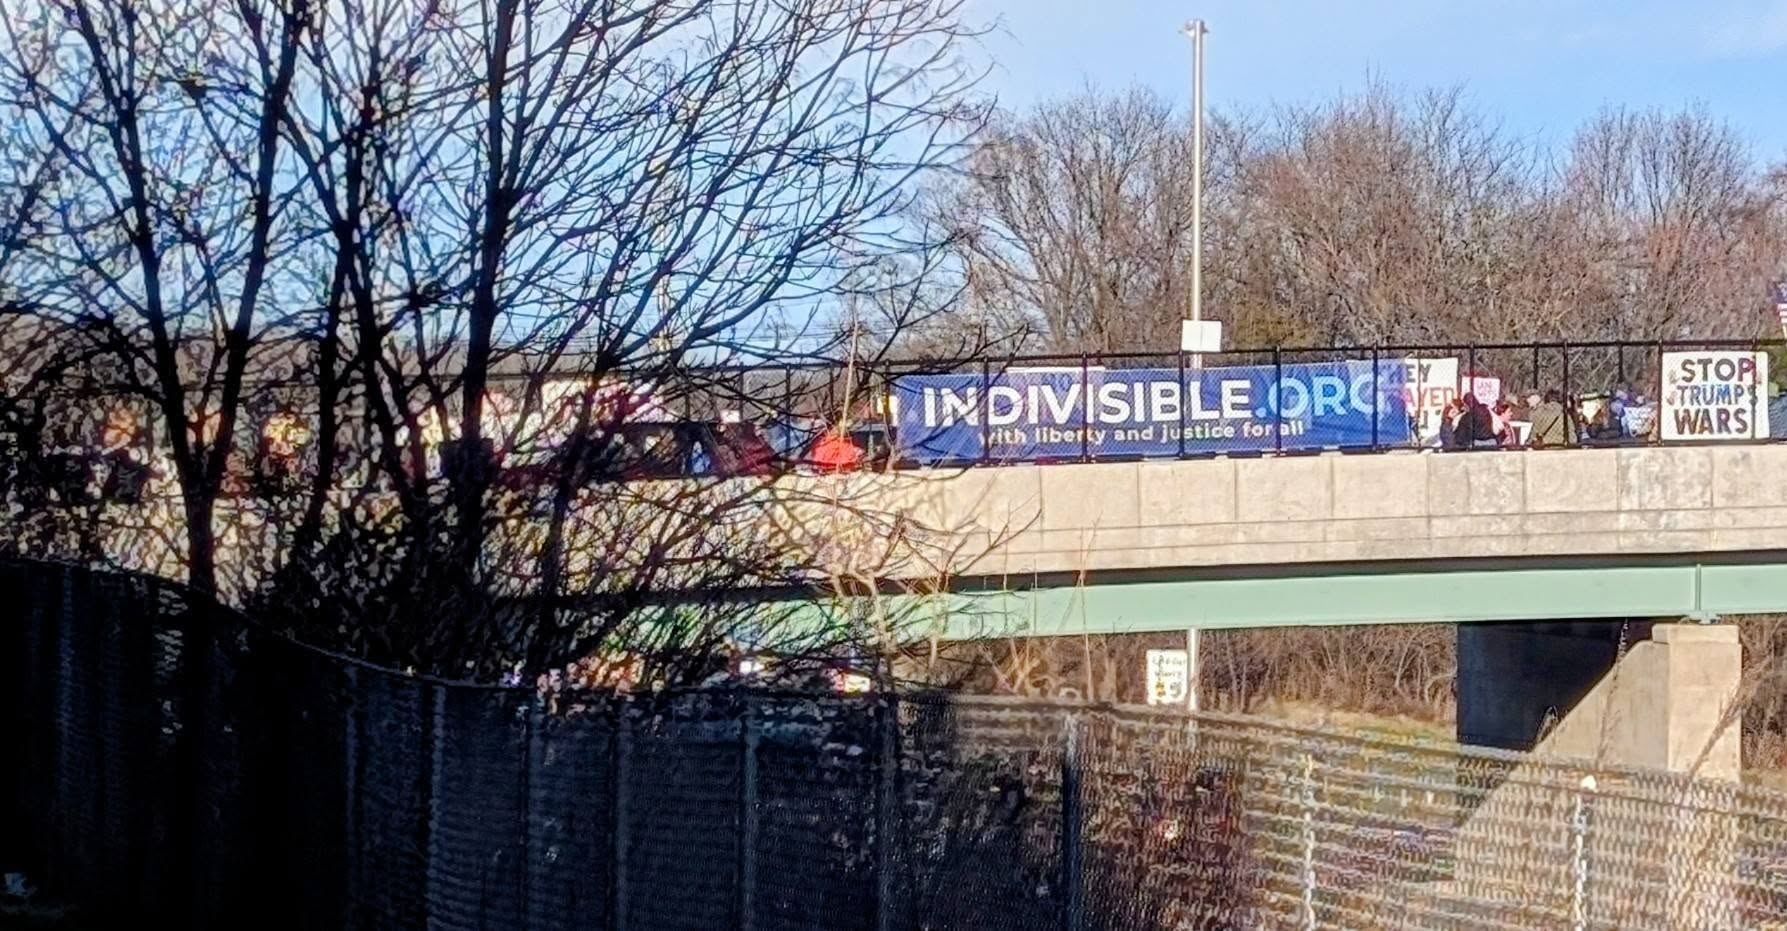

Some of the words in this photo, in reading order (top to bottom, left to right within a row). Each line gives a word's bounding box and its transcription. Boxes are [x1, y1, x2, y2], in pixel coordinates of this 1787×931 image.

[1681, 357, 1757, 382] STOP
[1114, 426, 1154, 441] and
[1161, 423, 1235, 442] justice
[1243, 422, 1274, 437] for
[1279, 420, 1304, 436] all
[1674, 408, 1749, 435] WARS
